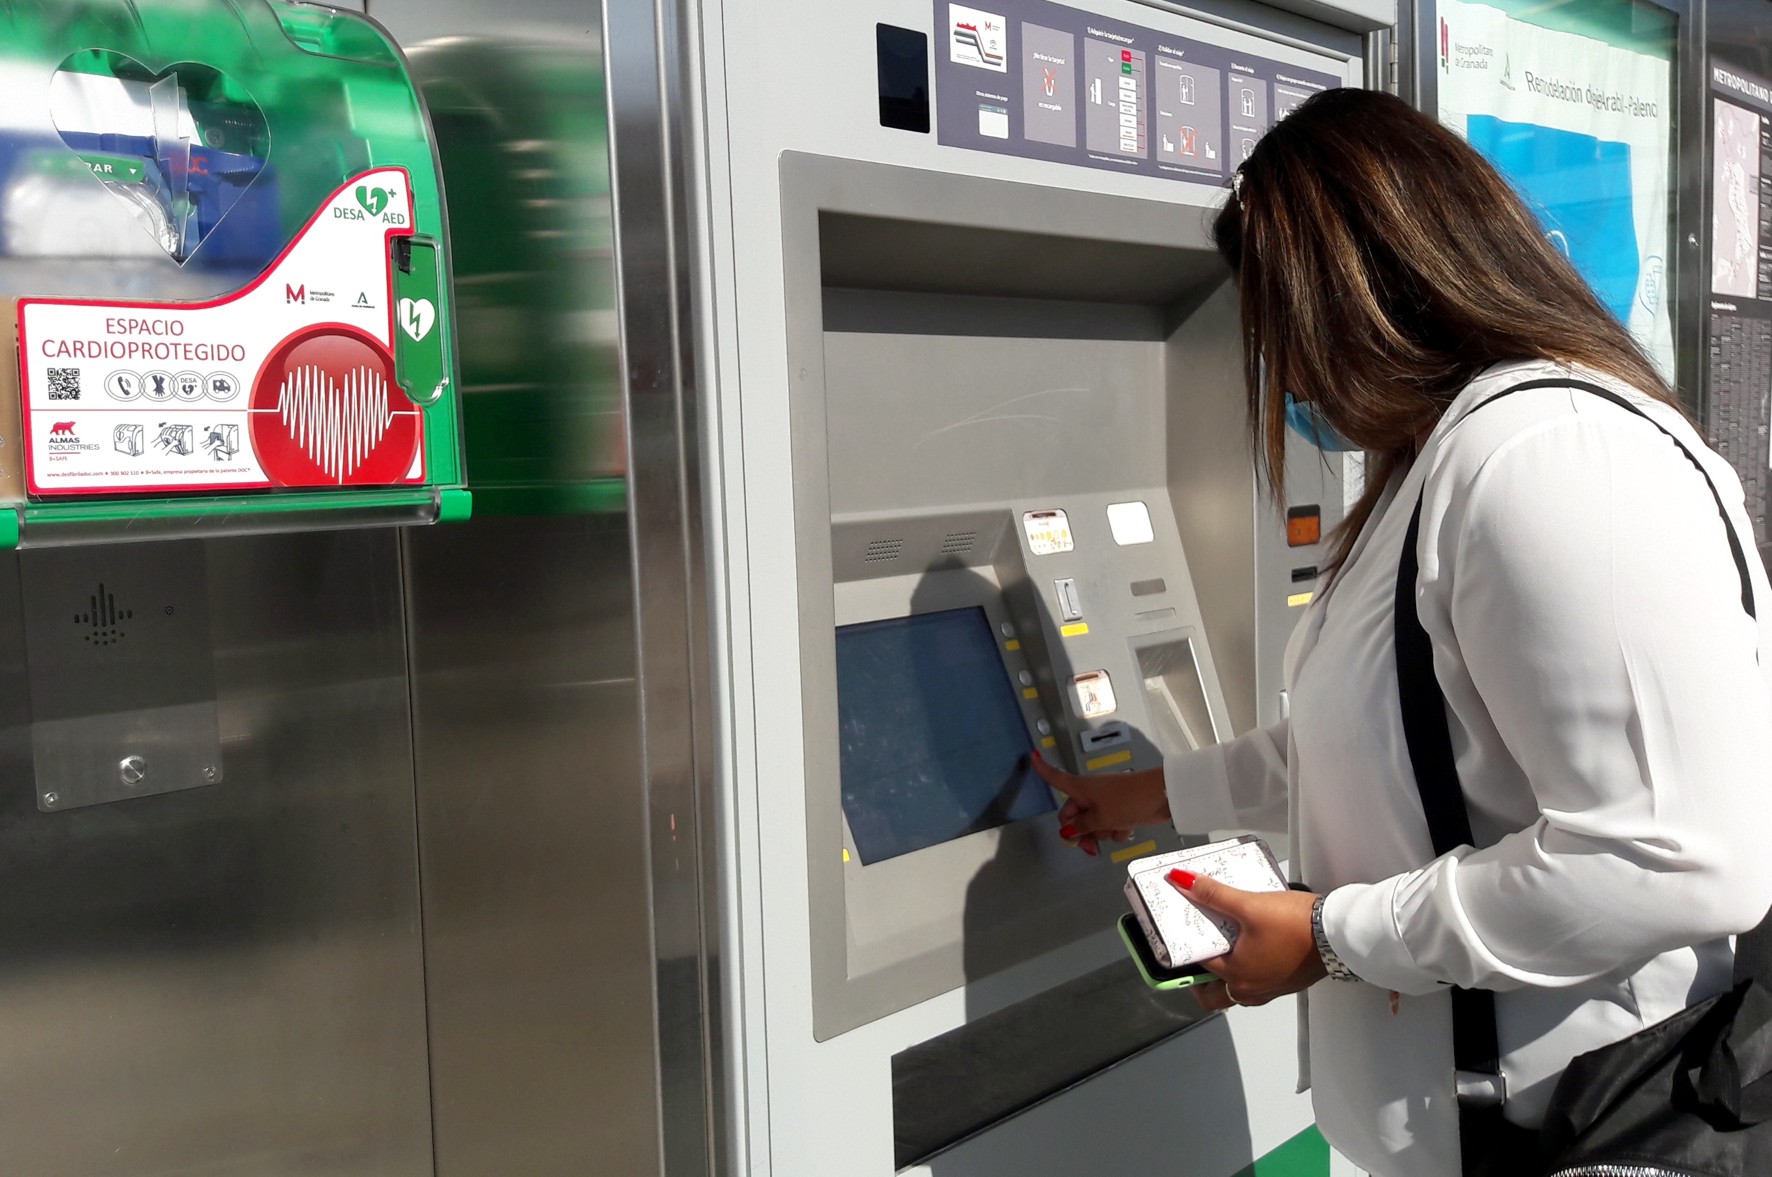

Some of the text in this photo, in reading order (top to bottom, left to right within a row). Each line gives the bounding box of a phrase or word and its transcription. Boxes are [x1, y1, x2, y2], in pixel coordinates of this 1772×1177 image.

[333, 206, 406, 225] DESA AED
[105, 317, 185, 337] ESPACIO
[41, 339, 246, 362] CARDIOPROTEGIDO
[48, 443, 101, 451] INDUSTRIES
